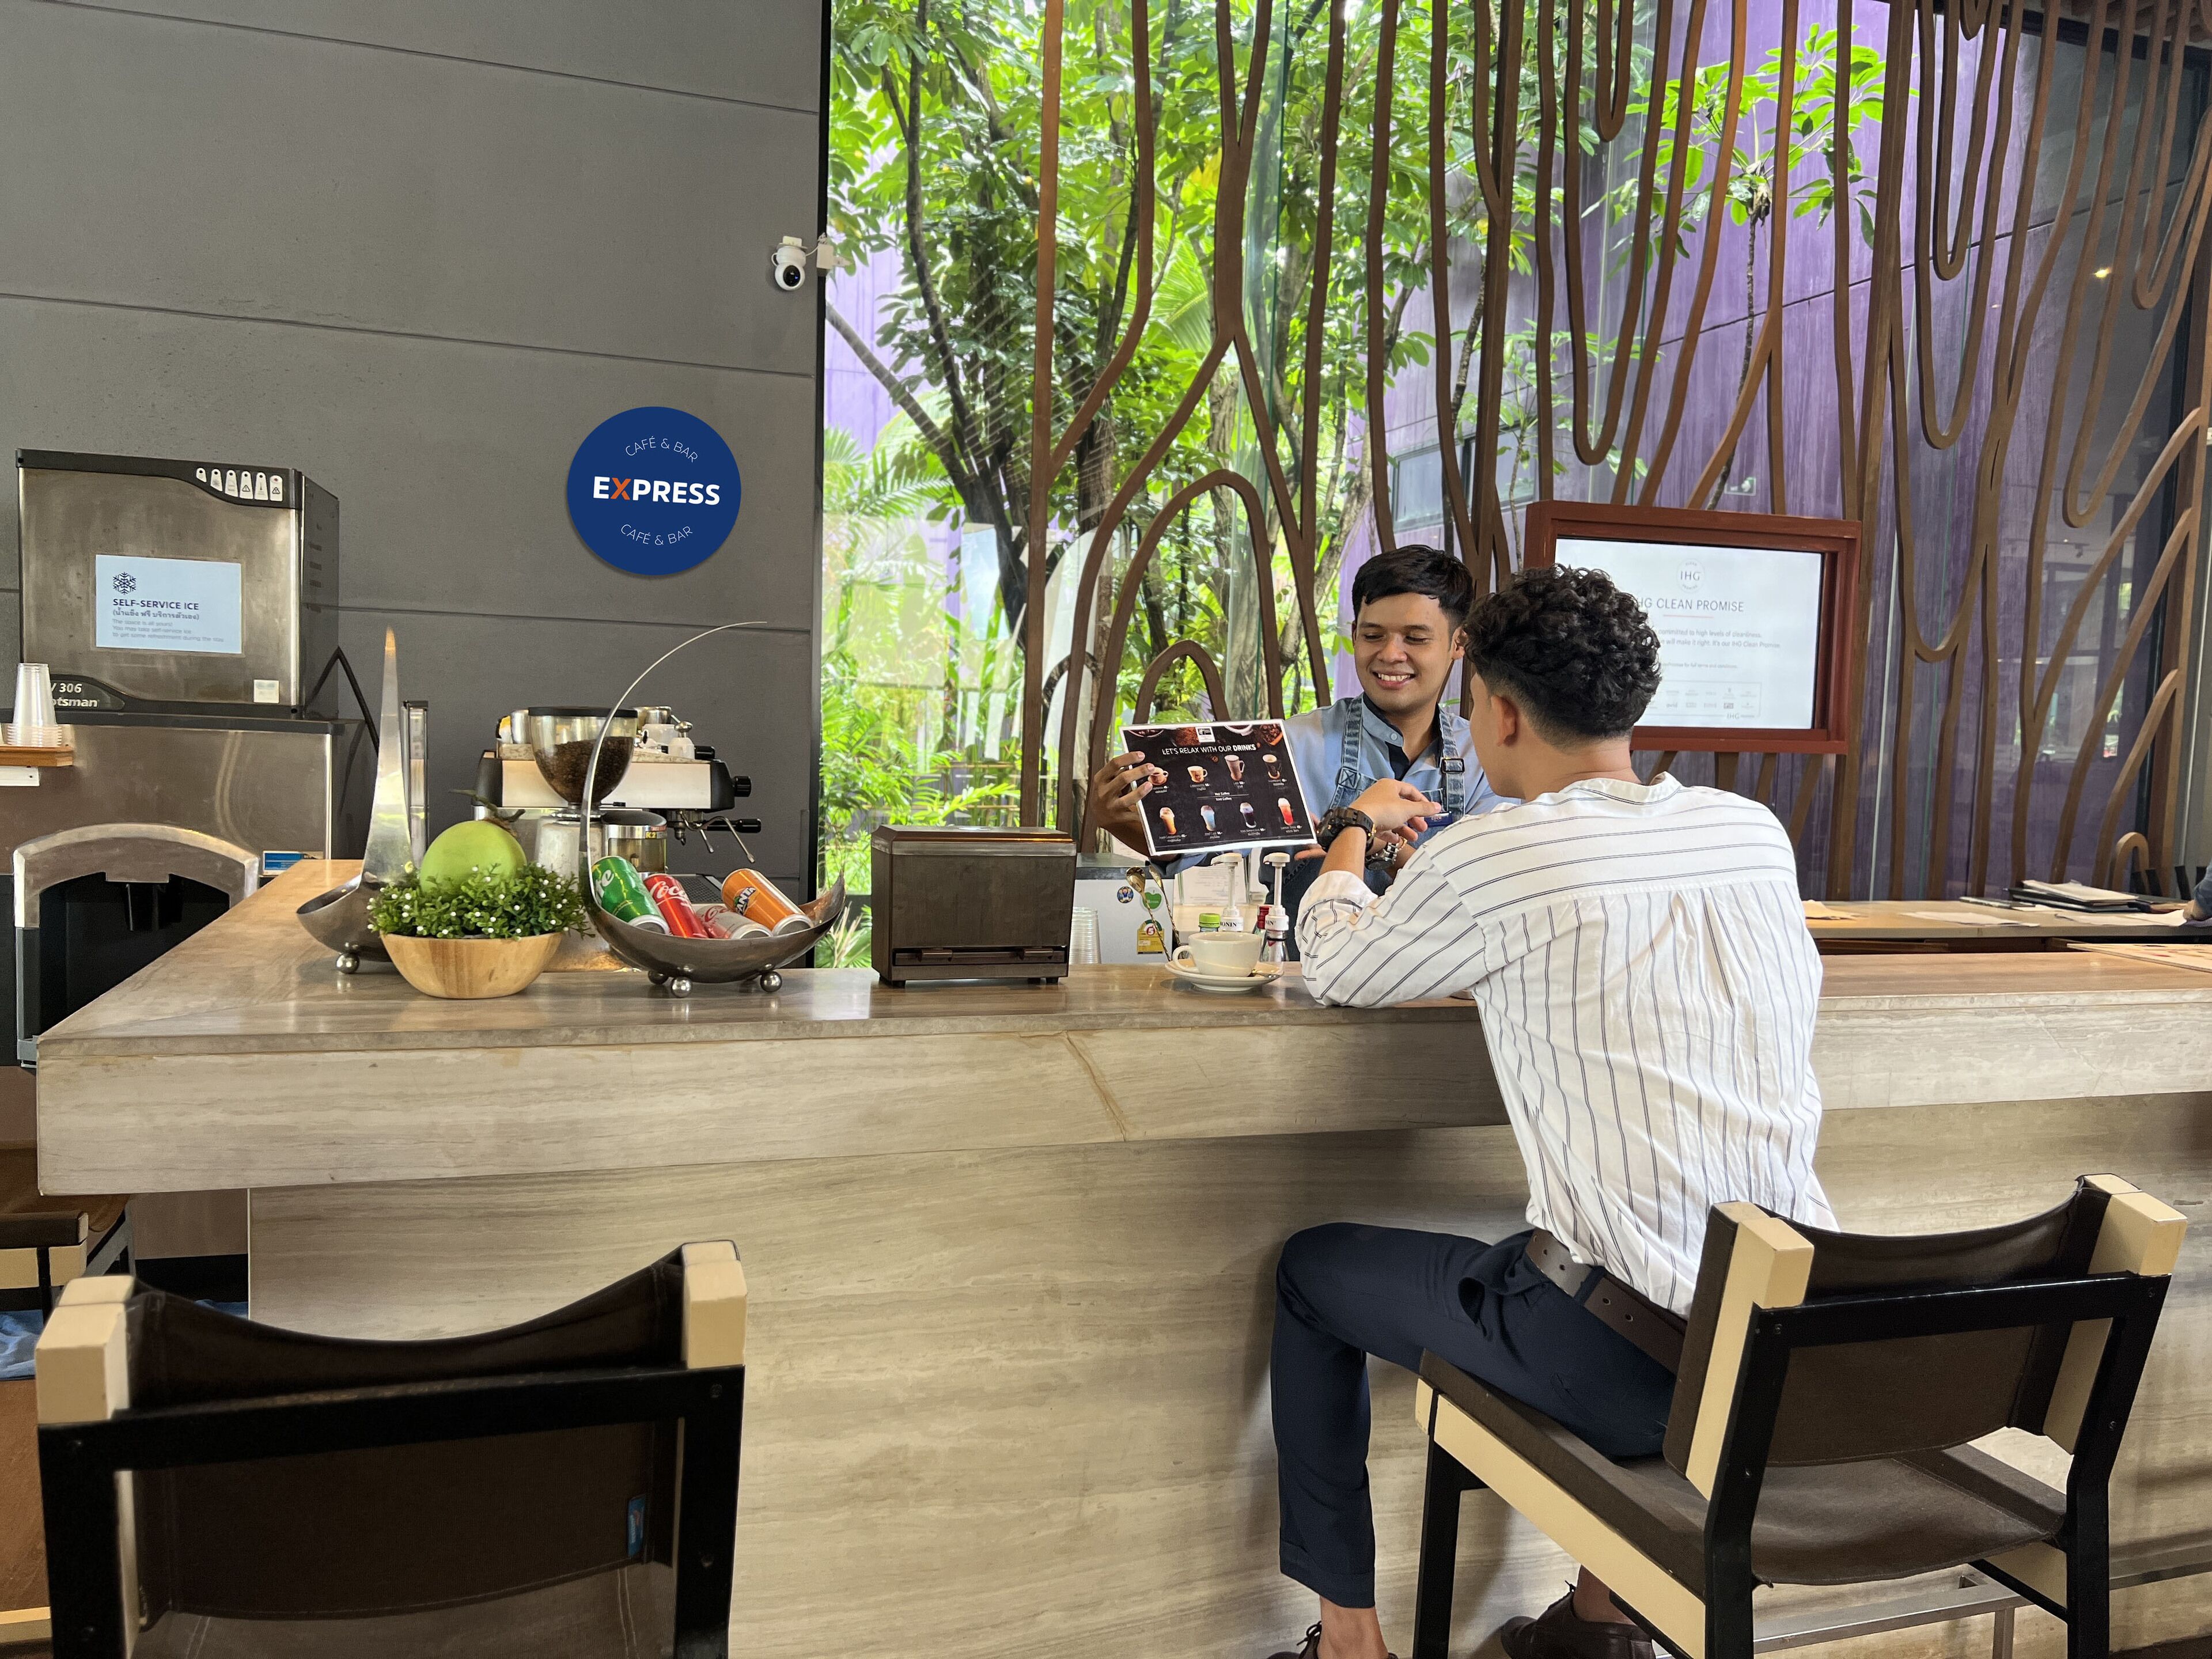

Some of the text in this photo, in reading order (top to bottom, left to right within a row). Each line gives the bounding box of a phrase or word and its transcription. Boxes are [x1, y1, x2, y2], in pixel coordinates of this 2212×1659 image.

[625, 435, 698, 463] CAFÉ & BAR
[593, 476, 721, 506] EXPRESS
[620, 524, 693, 546] CAFÉ & BAR
[1680, 571, 1700, 581] IHG
[113, 599, 199, 611] SELF-SERVICE ICE
[1637, 597, 1744, 612] HG CLEAN PROMISE
[59, 683, 82, 694] 306
[51, 697, 98, 707] otsman
[1232, 744, 1256, 752] DRINKS
